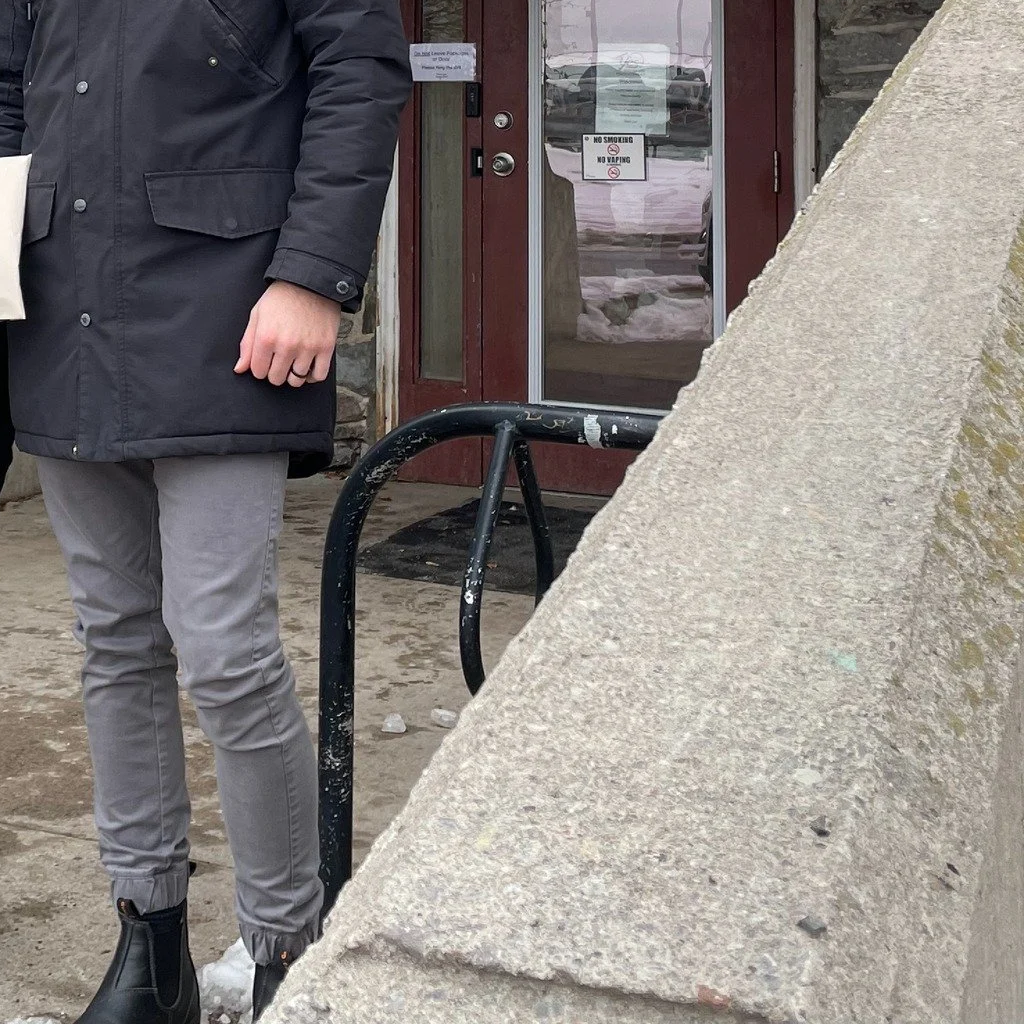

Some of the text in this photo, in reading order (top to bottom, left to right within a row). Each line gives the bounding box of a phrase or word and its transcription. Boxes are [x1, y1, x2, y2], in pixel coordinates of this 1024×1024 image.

[593, 136, 634, 144] NO SMOKING
[597, 156, 631, 164] NO VAPING
